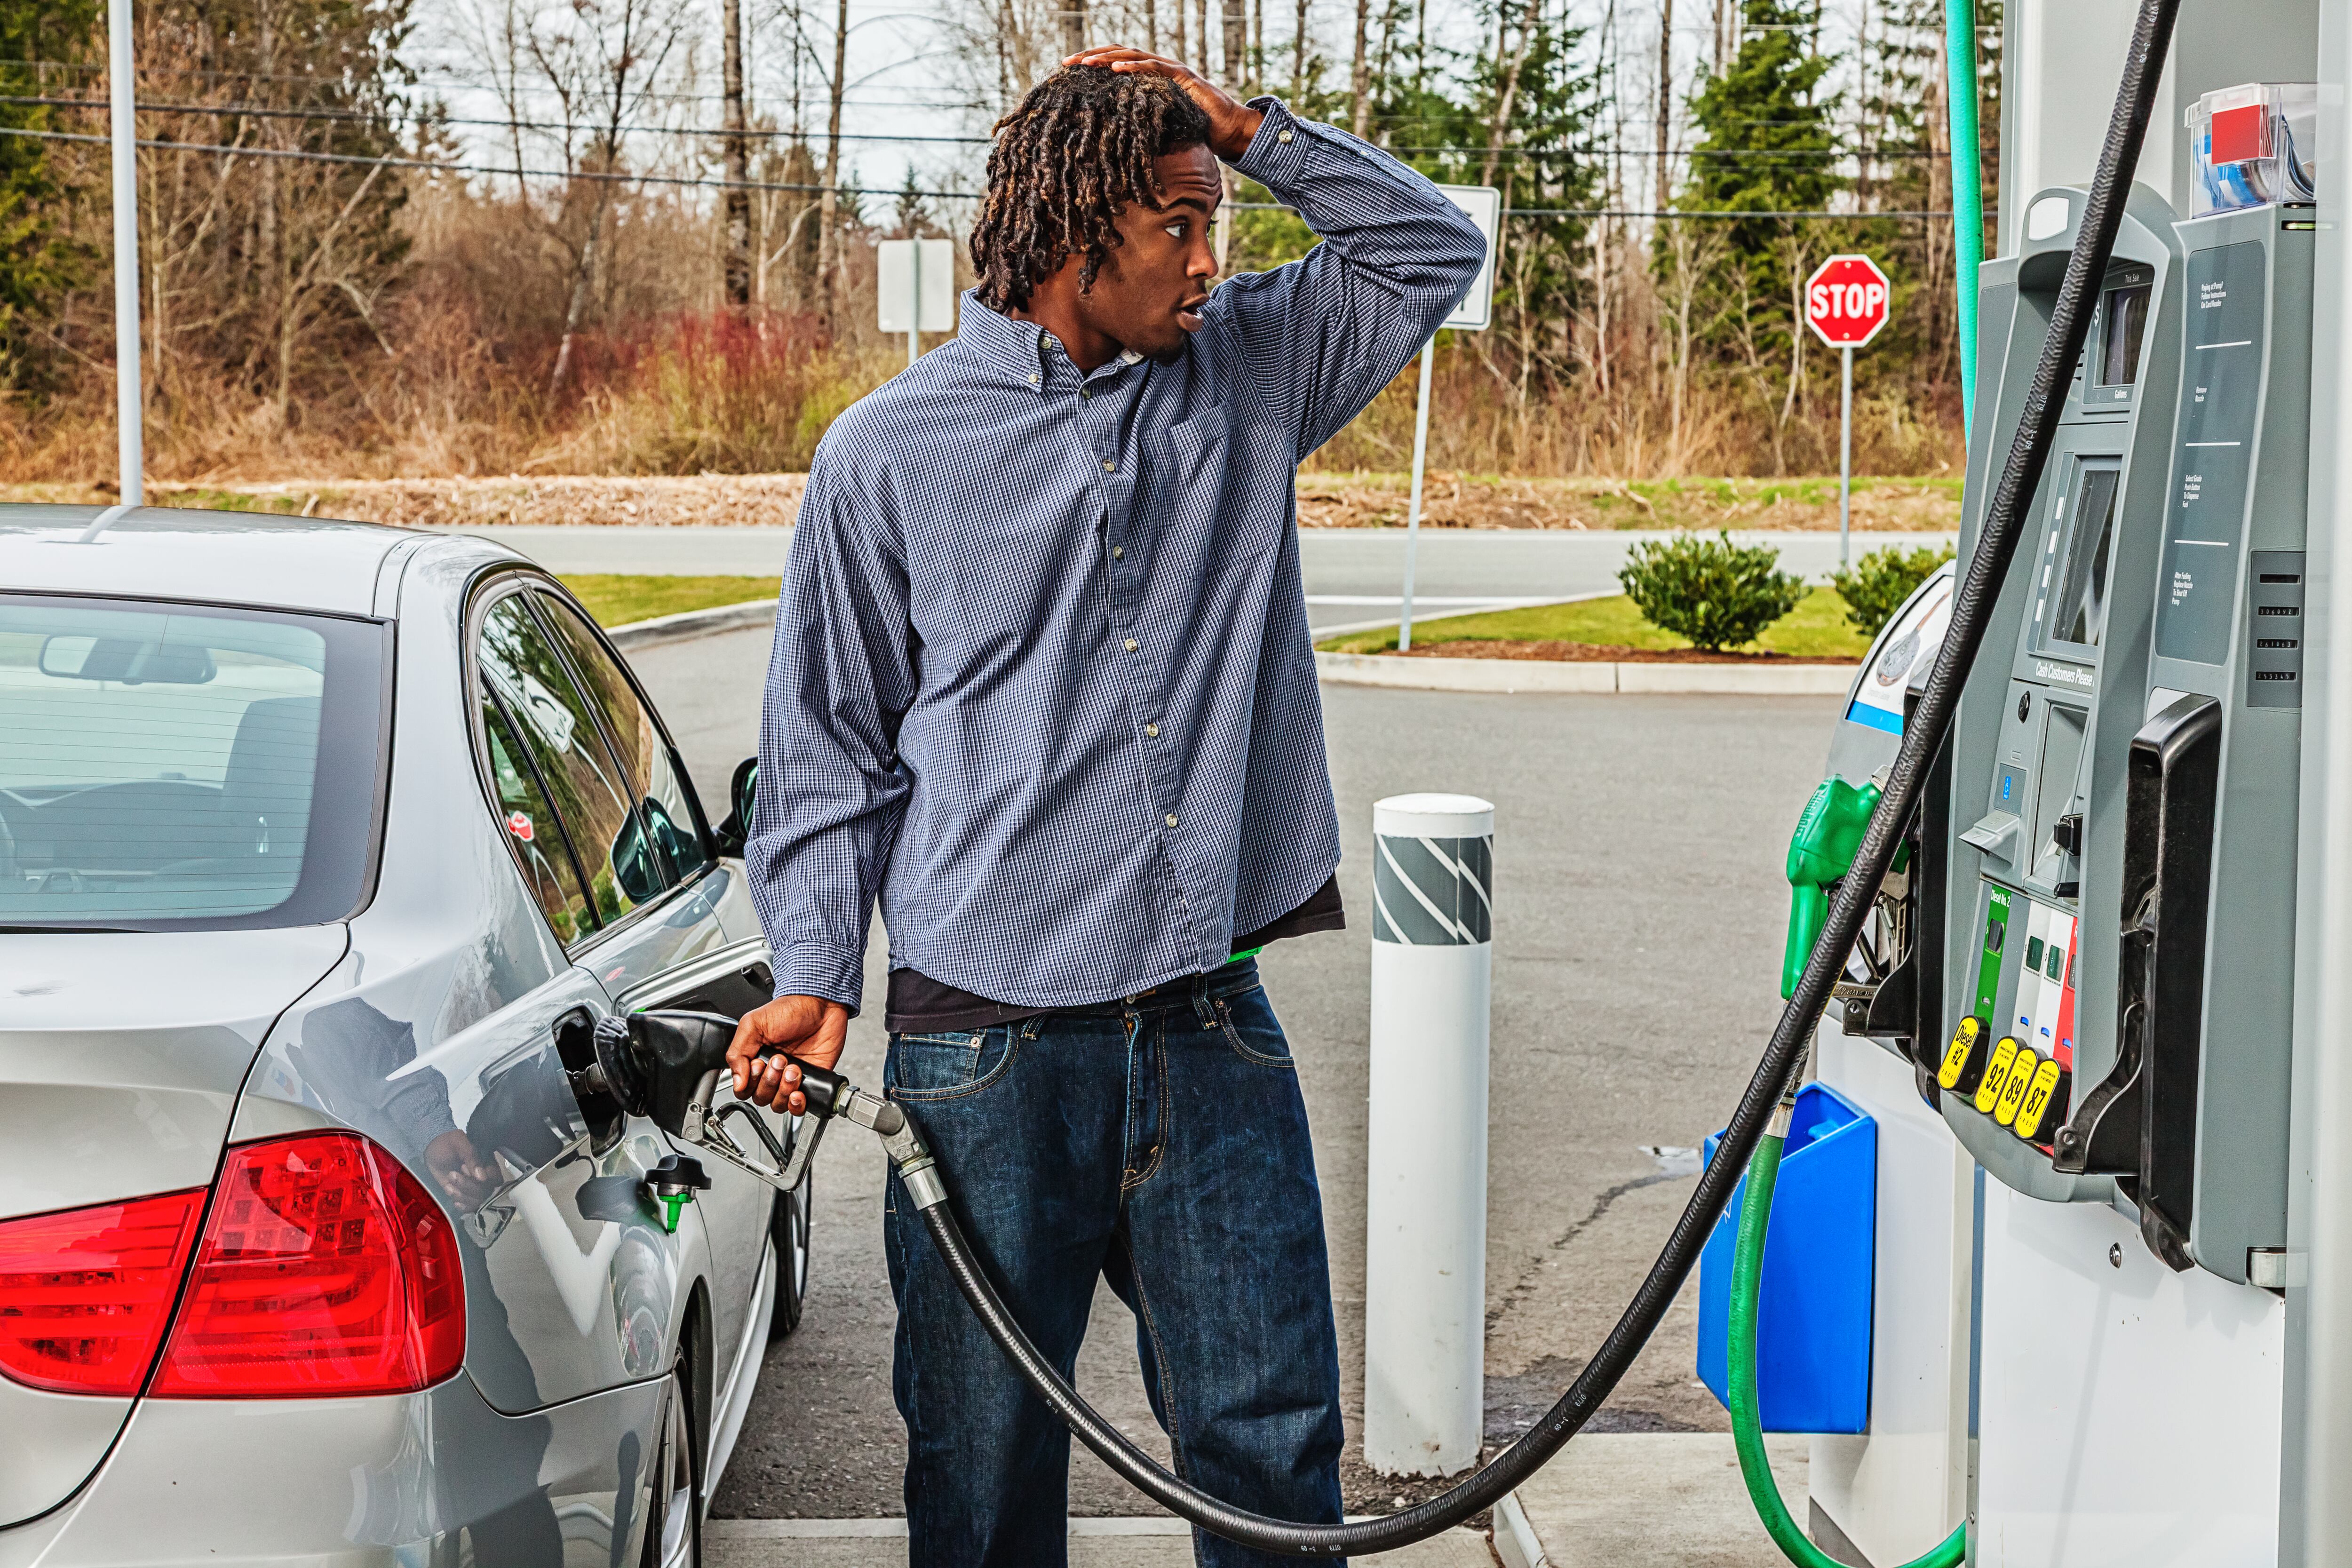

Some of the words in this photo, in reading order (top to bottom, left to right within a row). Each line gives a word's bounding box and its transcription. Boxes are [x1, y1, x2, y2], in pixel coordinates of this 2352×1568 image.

[2149, 6, 2159, 23] 0779
[1812, 283, 1884, 319] STOP
[2038, 395, 2047, 410] 0779
[2115, 390, 2127, 399] Gallons
[2035, 661, 2048, 677] Cash
[2048, 663, 2075, 683] Customers
[2075, 668, 2093, 687] Please
[1990, 889, 2002, 903] Diesel
[2007, 896, 2011, 907] 2
[1955, 1025, 1976, 1049] Diesel
[1951, 1046, 1963, 1066] #2
[1986, 1064, 2004, 1093] 92
[2005, 1075, 2024, 1105] 89
[2026, 1087, 2047, 1117] 87
[1575, 1394, 1586, 1406] 0779
